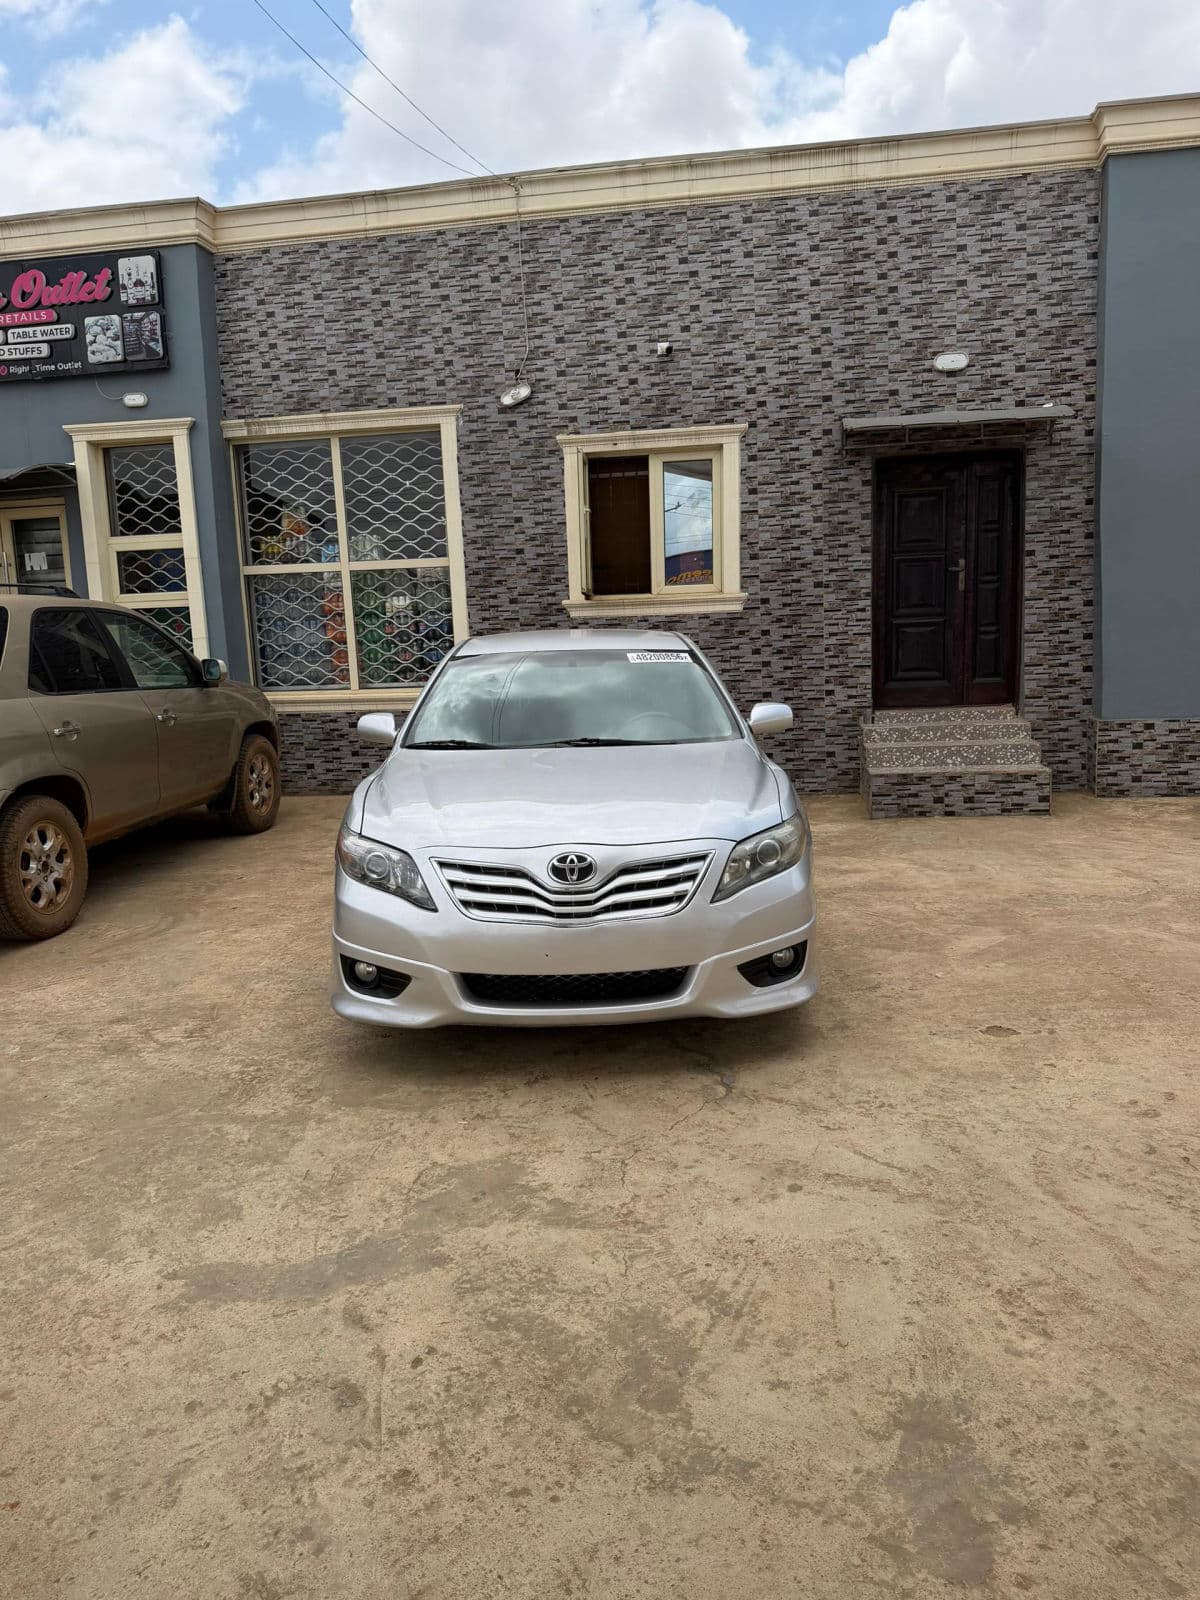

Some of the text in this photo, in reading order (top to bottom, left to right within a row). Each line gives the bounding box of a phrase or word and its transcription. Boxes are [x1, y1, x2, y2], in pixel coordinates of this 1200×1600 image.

[11, 267, 112, 308] Outlet
[11, 327, 70, 340] TABLE WATER
[7, 347, 42, 356] STUFFS
[9, 364, 30, 375] Right
[57, 361, 82, 370] Outlet
